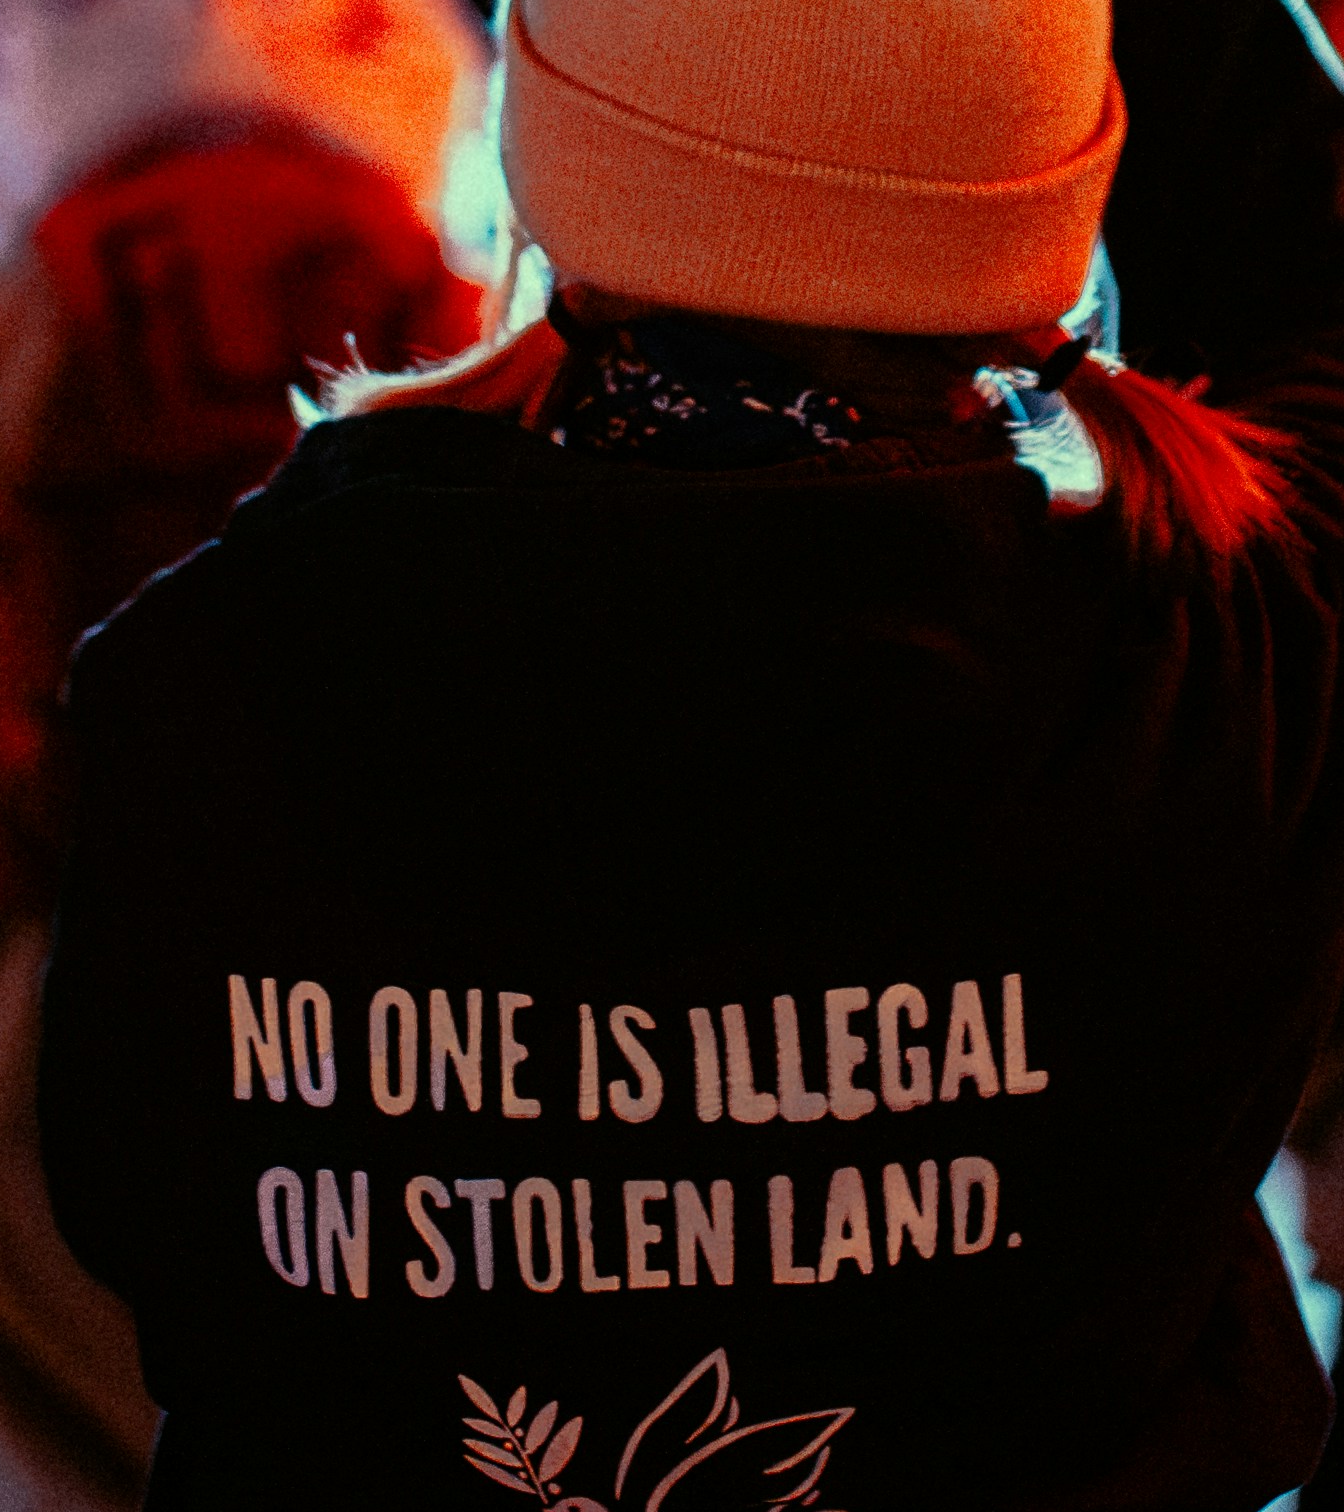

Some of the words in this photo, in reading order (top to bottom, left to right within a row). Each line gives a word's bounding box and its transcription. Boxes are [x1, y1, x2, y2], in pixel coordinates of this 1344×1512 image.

[229, 974, 336, 1107] NO
[369, 986, 541, 1119] ONE
[579, 1003, 662, 1122] IS
[689, 973, 1048, 1124] ILLEGAL
[258, 1166, 369, 1298] ON
[404, 1176, 734, 1297] STOLEN
[768, 1156, 1022, 1285] LAND.
